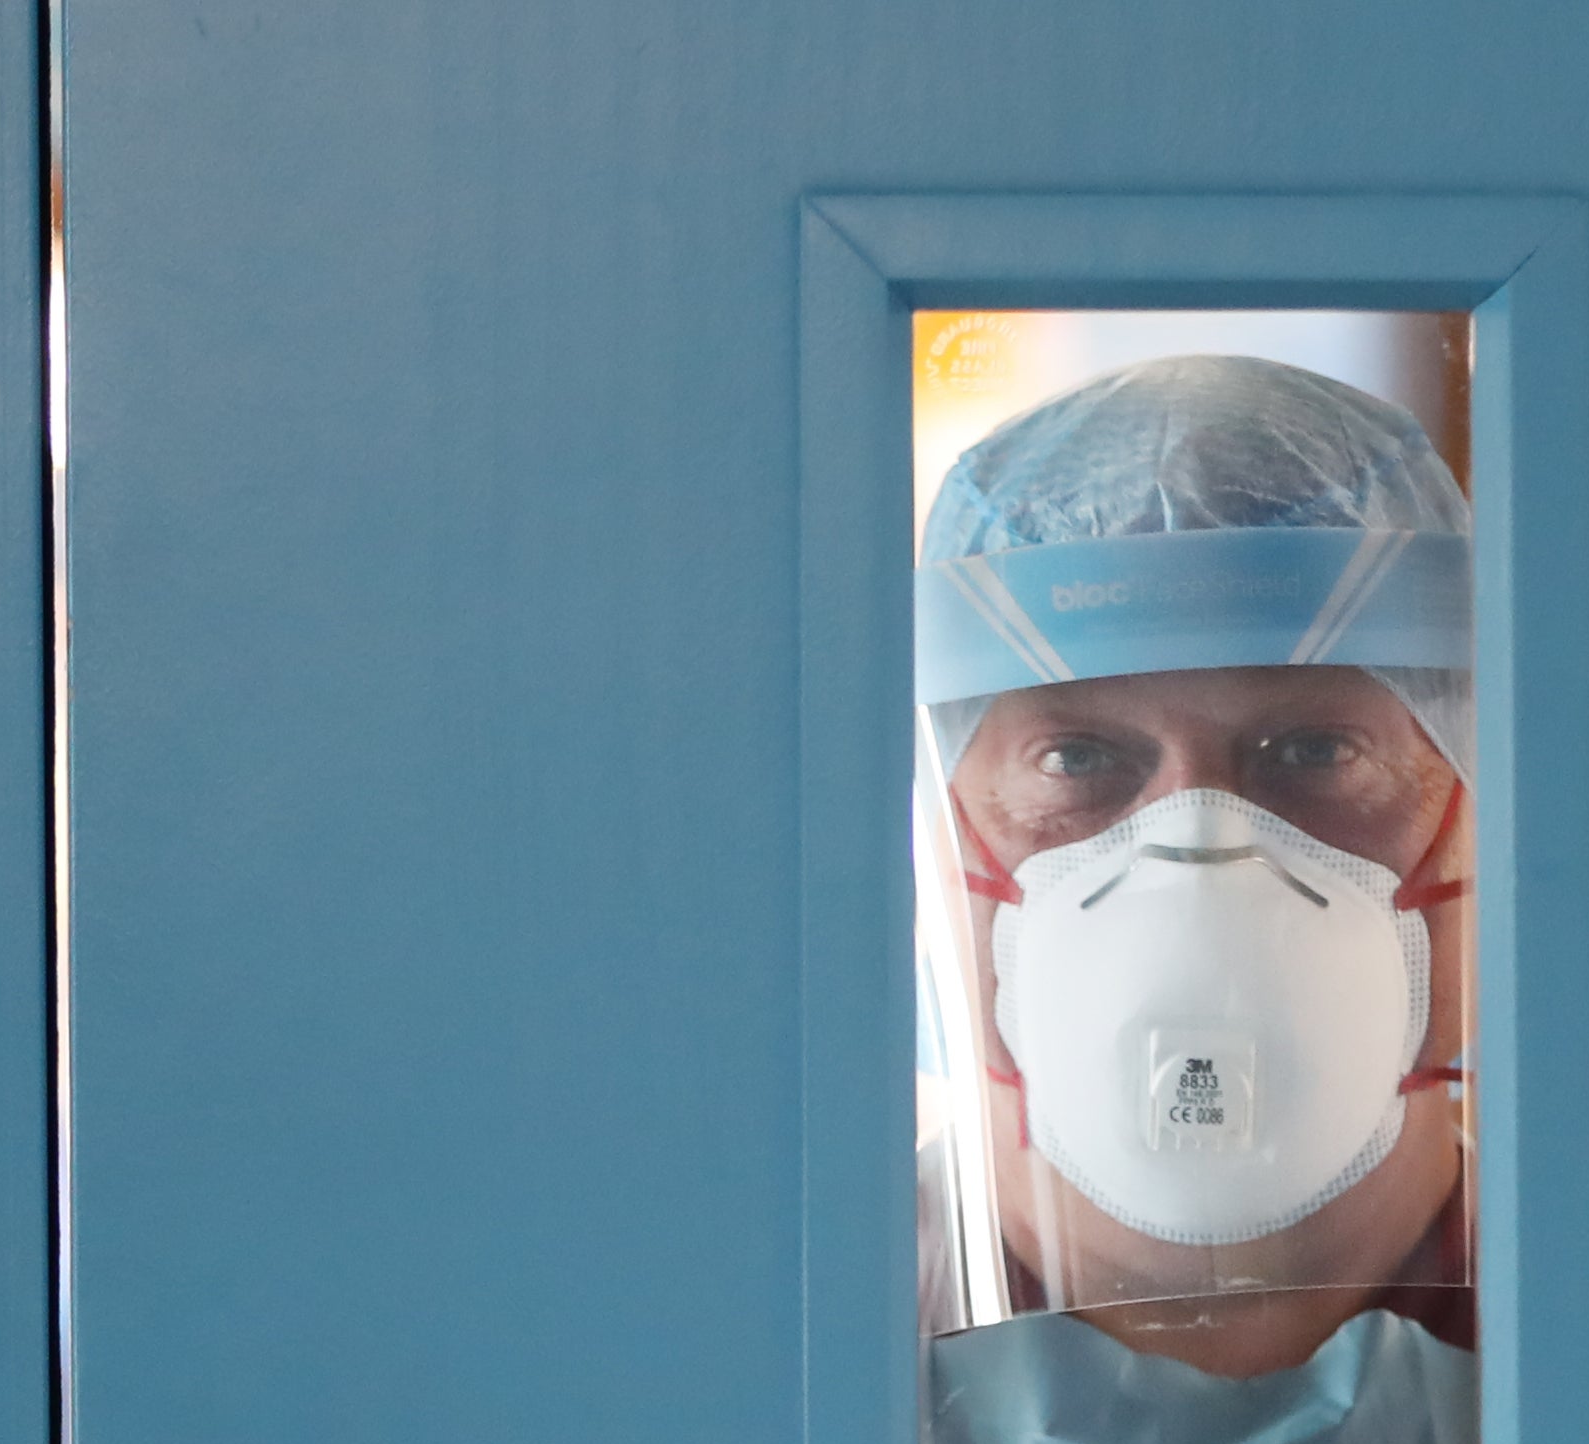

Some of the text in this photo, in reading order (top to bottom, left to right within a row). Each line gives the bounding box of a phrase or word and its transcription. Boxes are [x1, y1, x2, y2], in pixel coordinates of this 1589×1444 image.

[1186, 1058, 1213, 1073] 3M
[1180, 1074, 1218, 1089] 8833
[1170, 1106, 1192, 1124] CE
